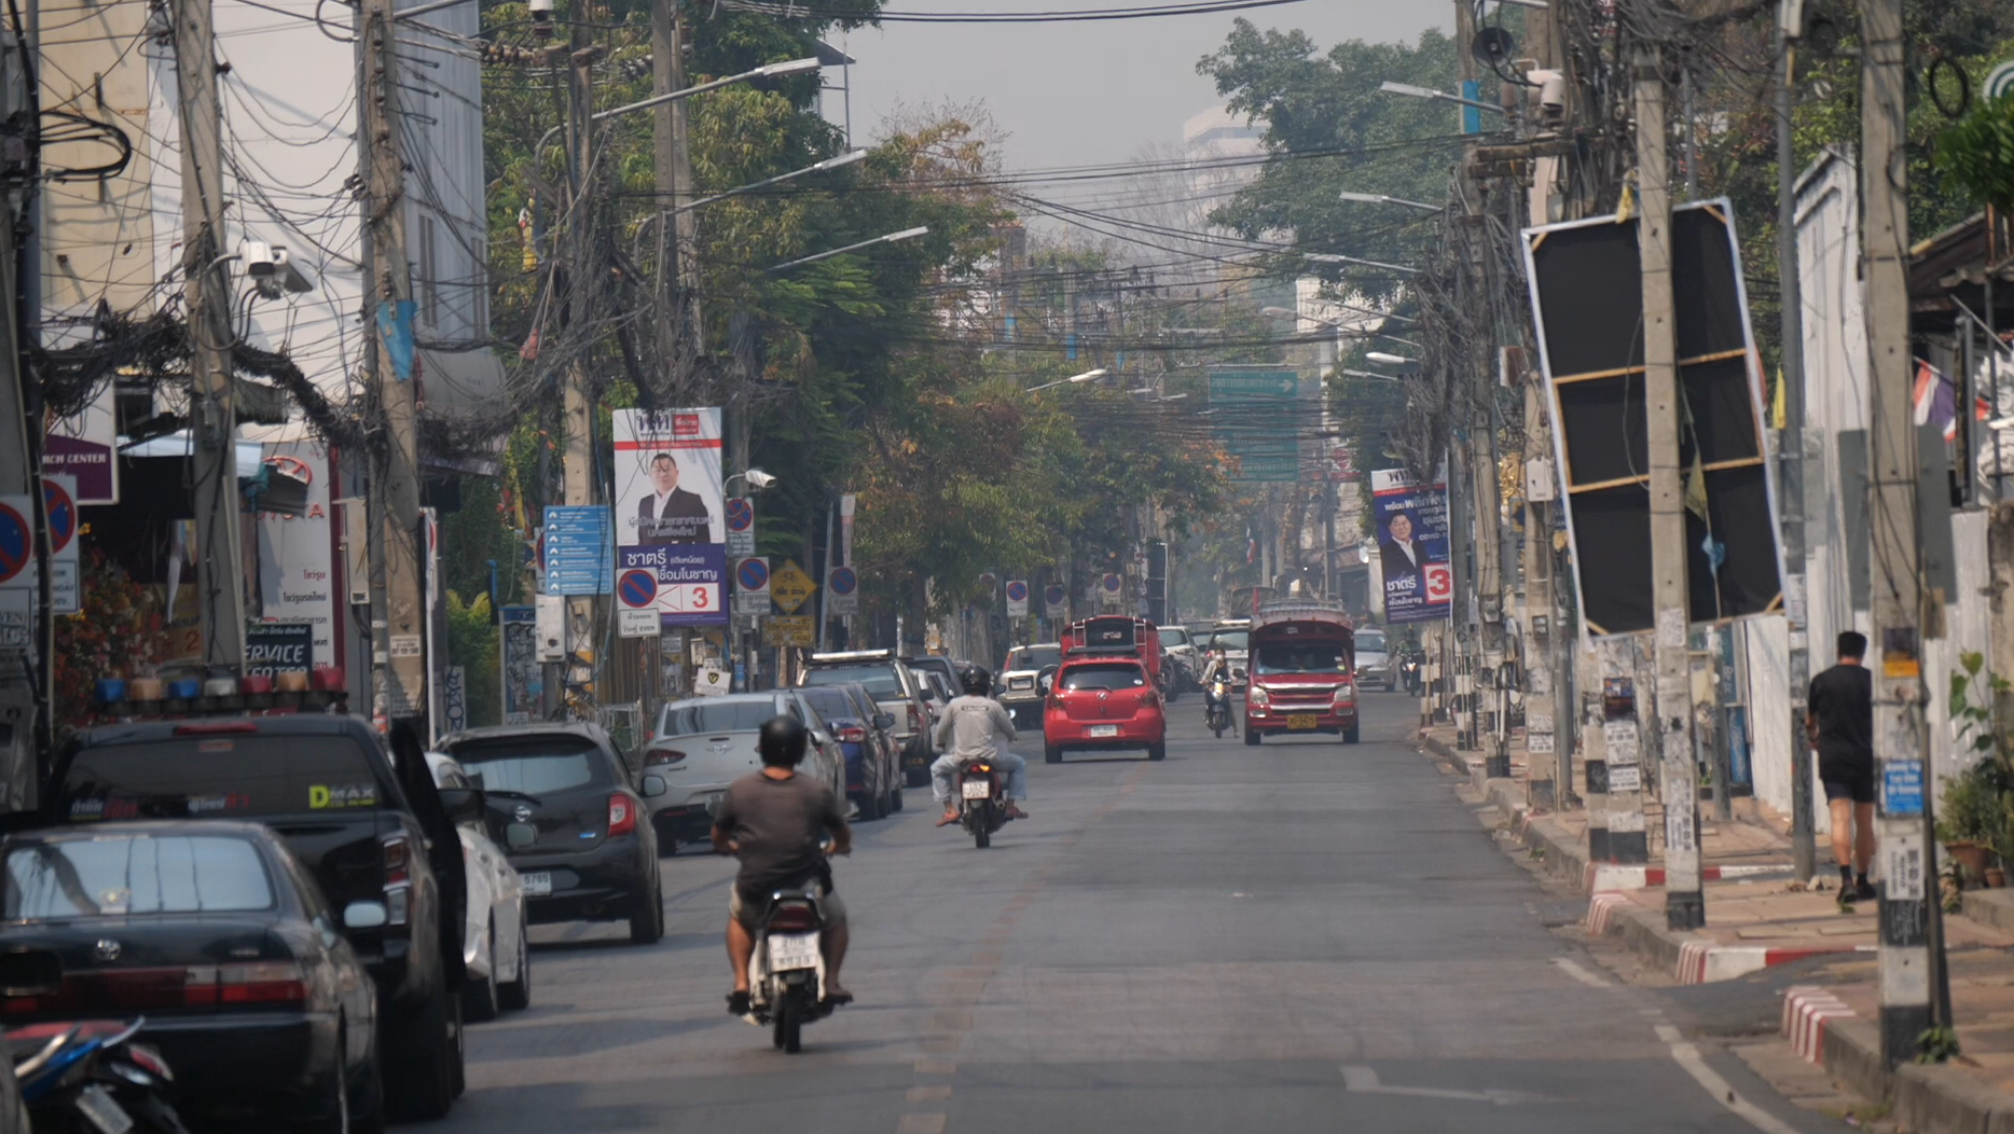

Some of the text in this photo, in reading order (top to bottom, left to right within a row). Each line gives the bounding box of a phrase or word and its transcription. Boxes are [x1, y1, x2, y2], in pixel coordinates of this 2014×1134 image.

[66, 453, 107, 463] CENTER
[627, 548, 666, 566] ชาตรี
[658, 566, 717, 581] ชื้อมโนชาญ
[1429, 569, 1450, 596] 3
[1386, 575, 1417, 591] ชาตรี
[692, 587, 708, 608] 3
[243, 644, 305, 663] ERVICE
